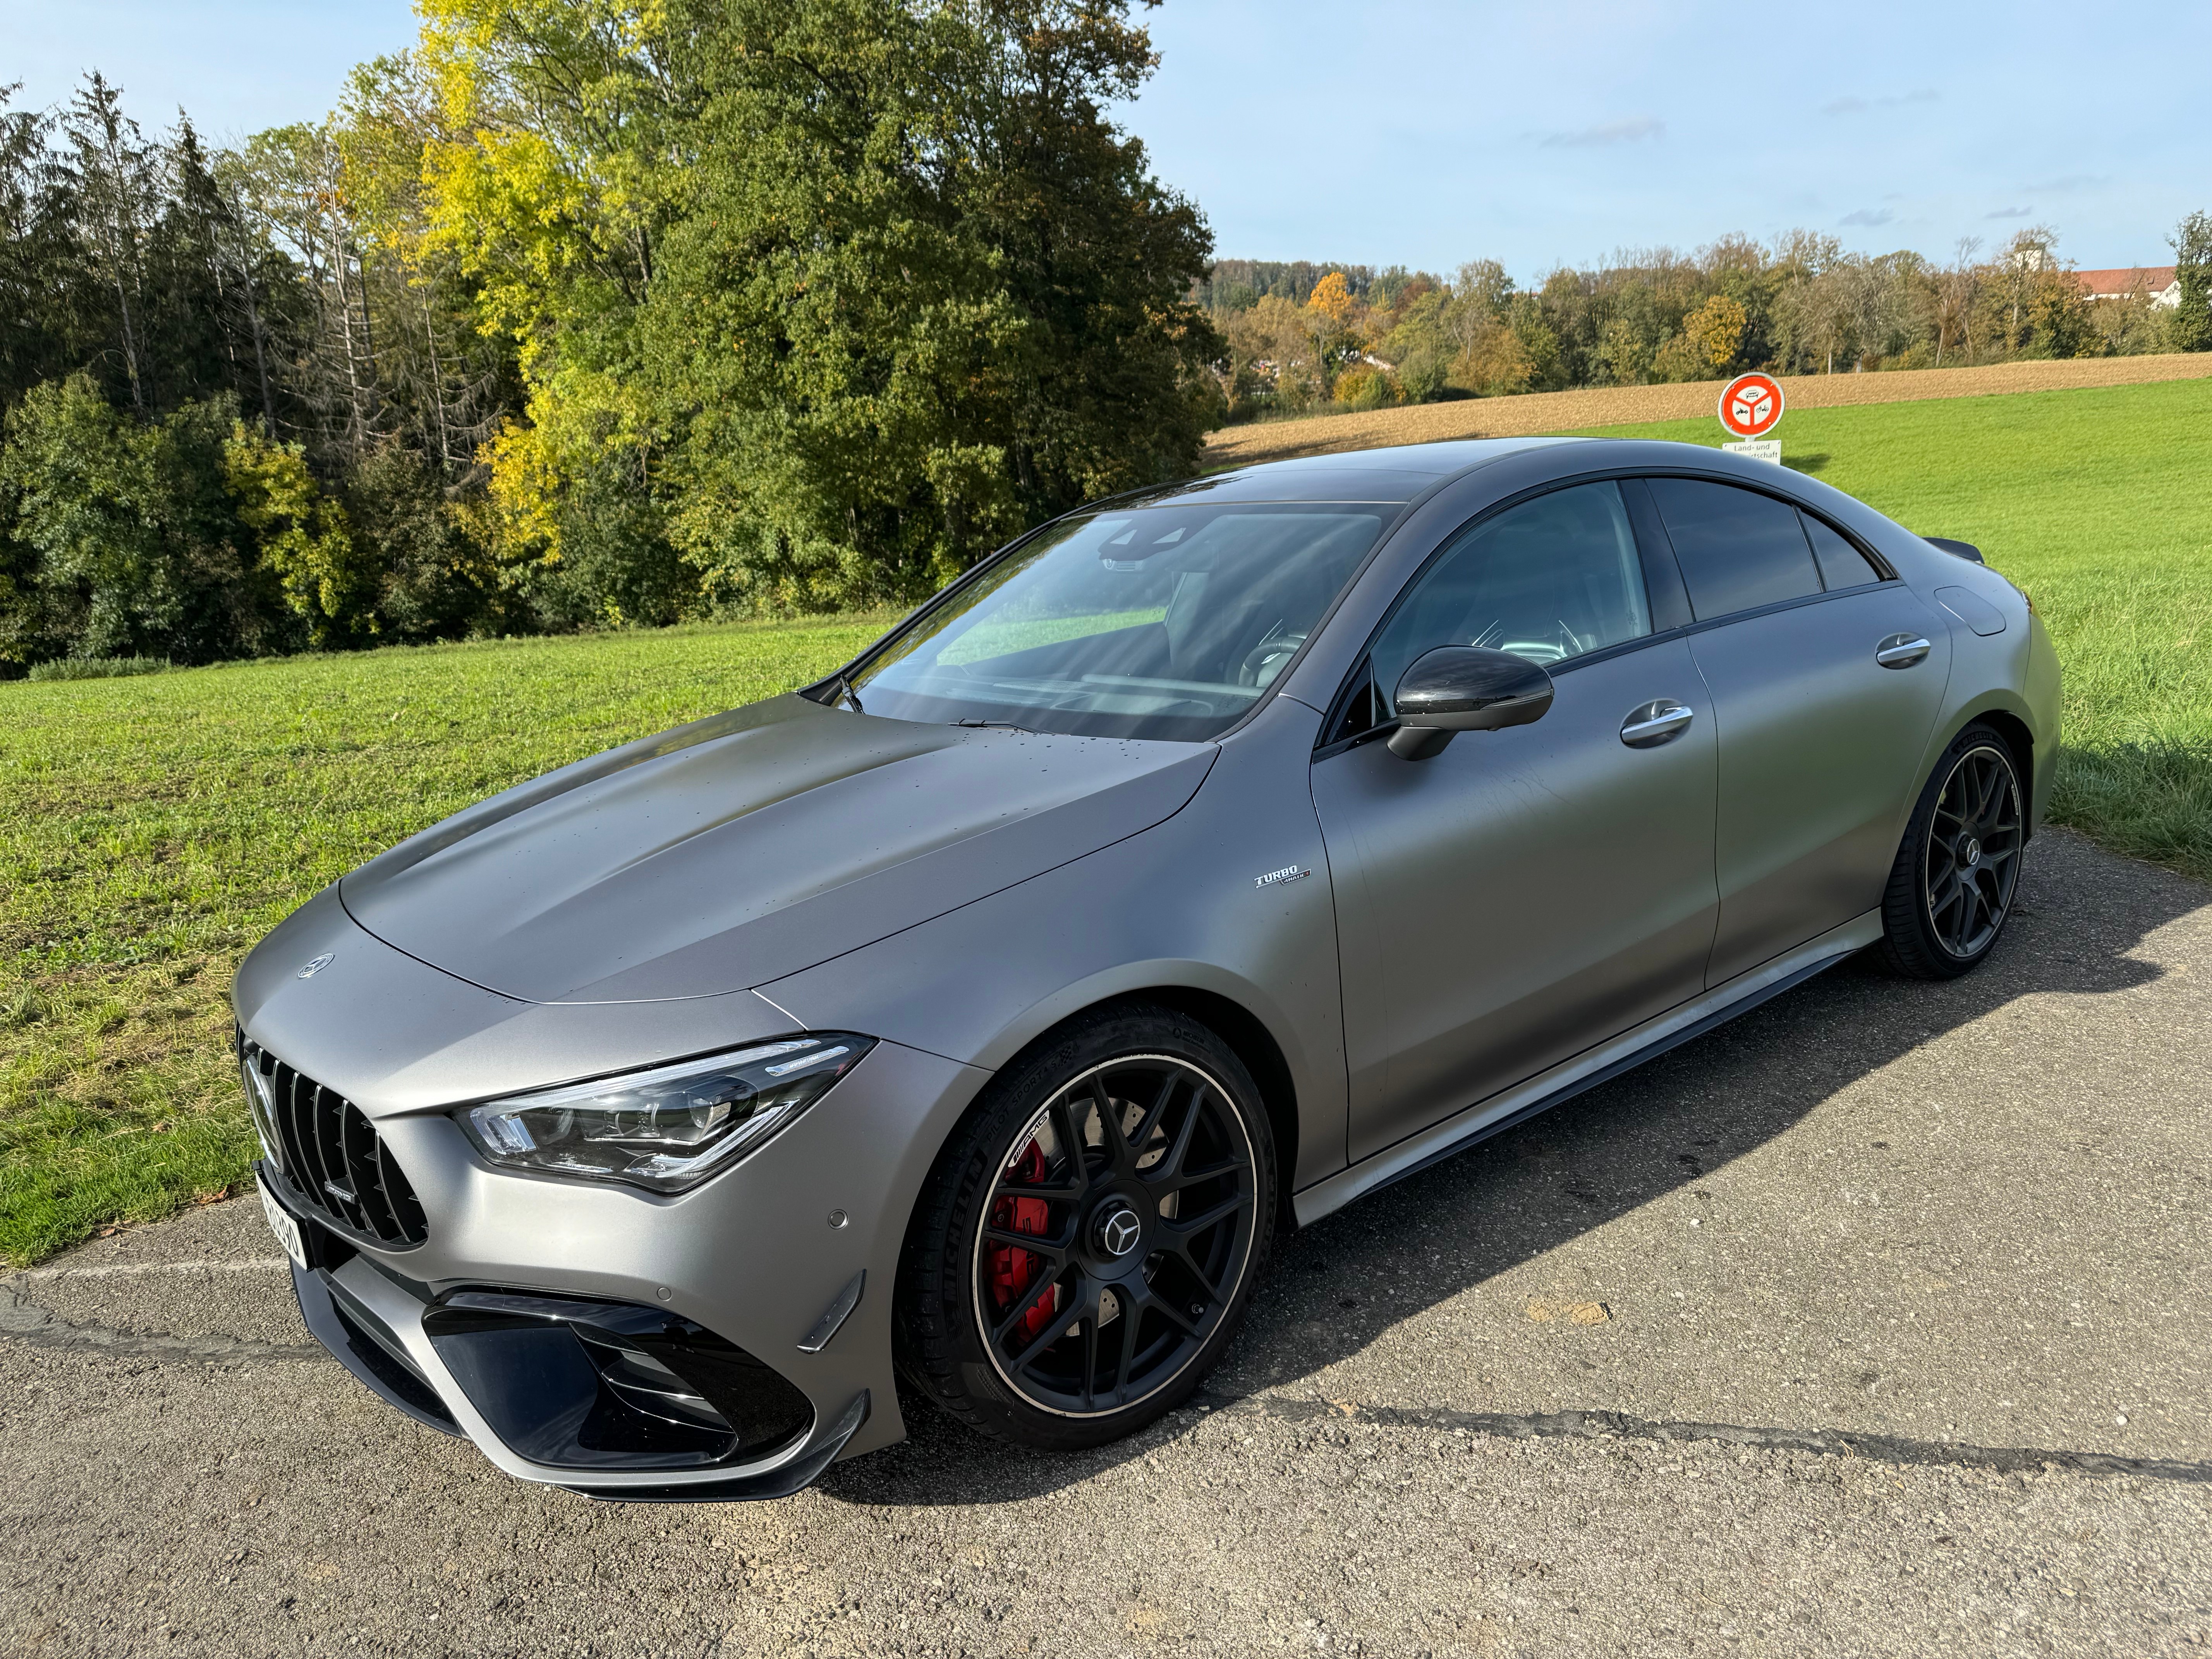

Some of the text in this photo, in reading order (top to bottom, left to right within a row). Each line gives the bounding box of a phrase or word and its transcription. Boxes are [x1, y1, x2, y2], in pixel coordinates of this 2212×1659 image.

[1963, 732, 1993, 747] MICHELIN
[1254, 865, 1297, 885] TURBO
[986, 1106, 1009, 1142] PILOT
[1012, 1070, 1042, 1106] SPORT
[944, 1157, 982, 1301] MICHELIN
